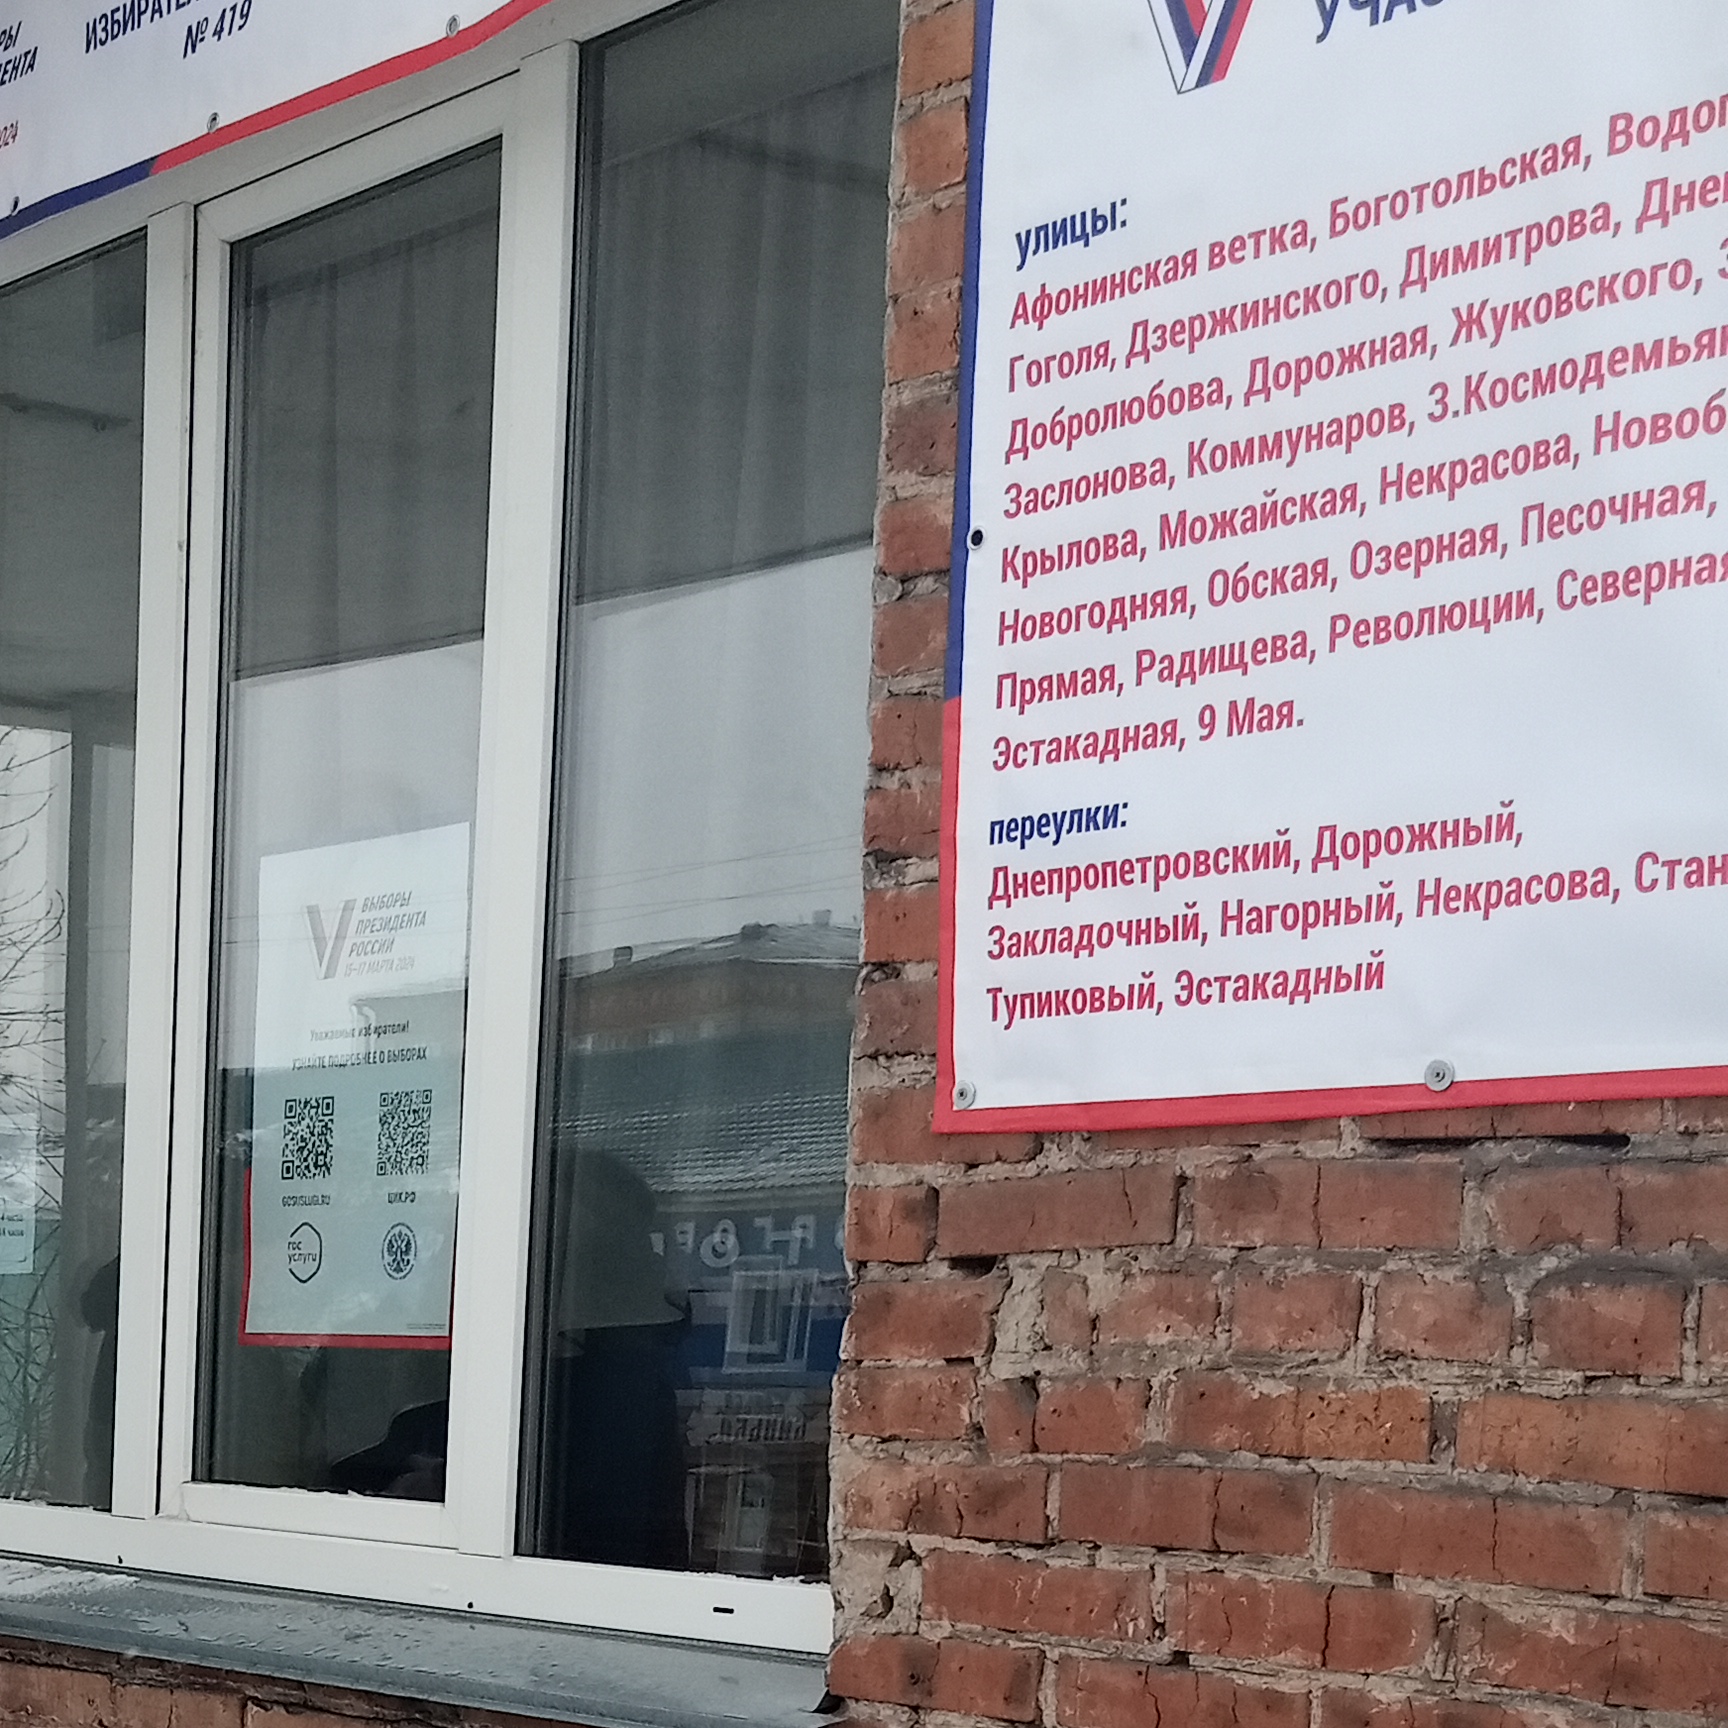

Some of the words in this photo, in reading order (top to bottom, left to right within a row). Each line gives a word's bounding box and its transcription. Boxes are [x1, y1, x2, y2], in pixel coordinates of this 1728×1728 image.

[85, 0, 198, 54] ИЗБИРА
[212, 0, 252, 42] 419
[1009, 248, 1197, 331] Афонинская
[1208, 219, 1317, 271] ветка,
[1329, 134, 1591, 239] Боготольская,
[1015, 198, 1127, 272] улицы:
[1008, 340, 1116, 393] Гоголя,
[1125, 269, 1387, 369] Дзержинского,
[1399, 202, 1621, 299] Димитрова,
[1635, 171, 1728, 234] Дне
[1004, 377, 1232, 465] Добролюбова,
[1244, 325, 1437, 407] Дорожная,
[1449, 258, 1702, 348] Жуковского,
[1003, 457, 1175, 519] Заслонова,
[1188, 403, 1415, 479] Коммунаров,
[1428, 324, 1728, 422] З.Космодемья
[1001, 529, 1147, 589] Крылова,
[1159, 482, 1366, 551] Можайская,
[1379, 433, 1579, 505] Некрасова,
[1593, 388, 1726, 456] Новоб
[998, 585, 1196, 646] Новогодняя,
[1208, 557, 1337, 607] Обская,
[1350, 523, 1507, 580] Озерная,
[1521, 480, 1717, 547] Песочная,
[996, 664, 1124, 716] Прямая,
[1135, 630, 1316, 688] Радищева,
[1329, 587, 1544, 653] Революции,
[993, 718, 1186, 771] Эстакадная,
[1198, 704, 1216, 741] 9
[1227, 697, 1304, 737] Мая.
[988, 828, 1300, 910] Днепропетровский,
[1311, 799, 1522, 873] Дорожный,
[989, 802, 1128, 850] переулки:
[355, 910, 427, 935] ПРЕЗИДЕНТА
[361, 890, 412, 913] ВЫБОРЫ
[987, 901, 1208, 960] Закладочный,
[1220, 880, 1403, 940] Нагорный,
[1416, 867, 1620, 921] Некрасова,
[349, 936, 395, 957] РОССИИ
[986, 971, 1163, 1031] Тупиковый,
[1174, 949, 1384, 1007] Эстакадный
[387, 1046, 428, 1063] ВЫБОРАХ
